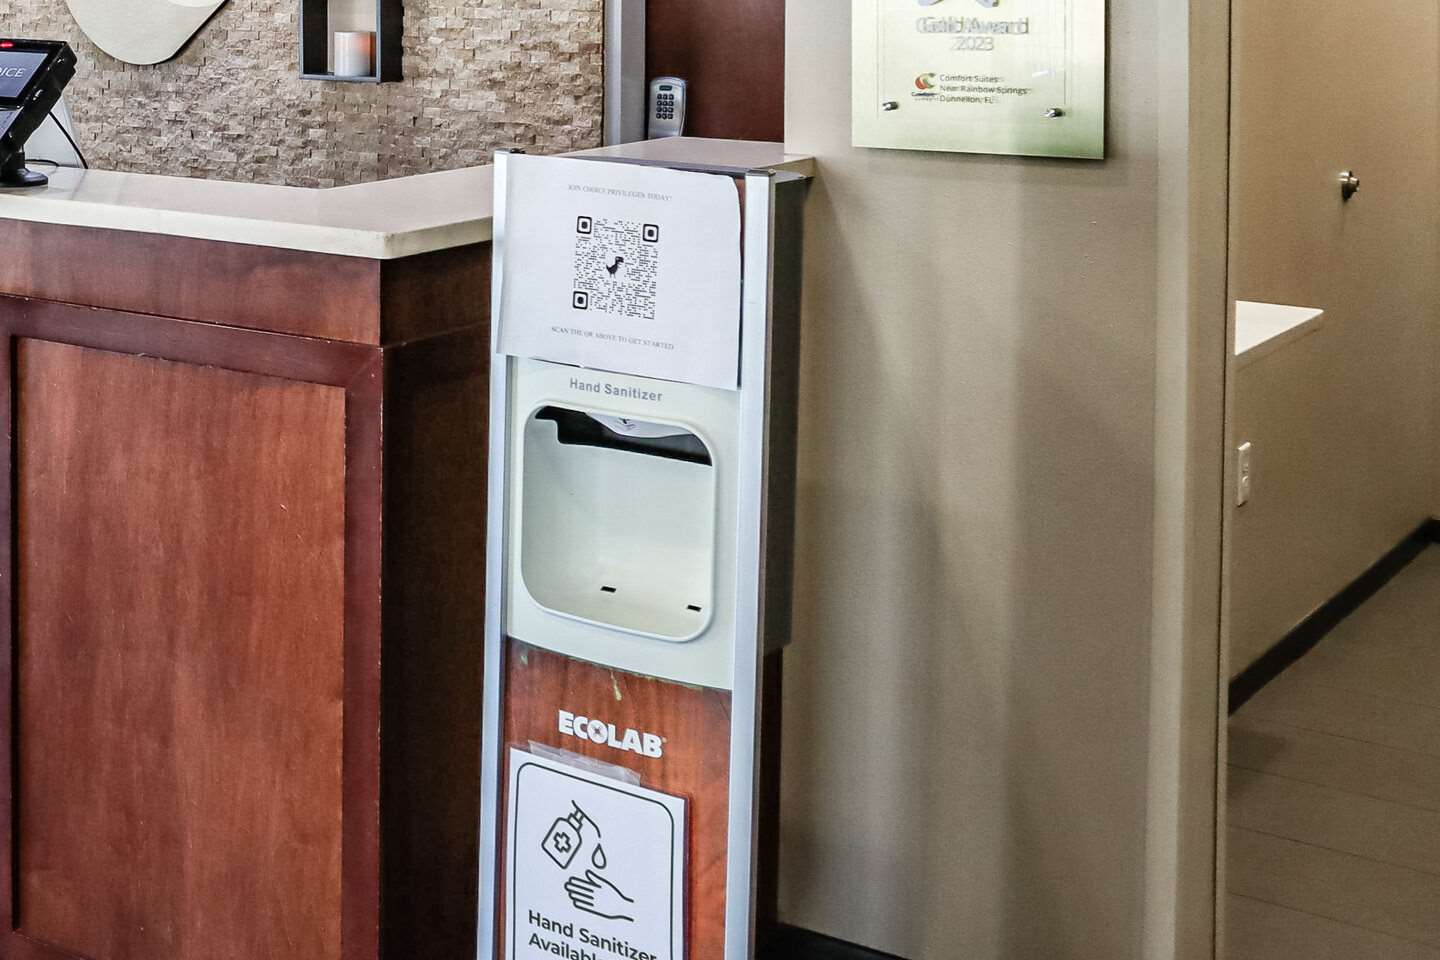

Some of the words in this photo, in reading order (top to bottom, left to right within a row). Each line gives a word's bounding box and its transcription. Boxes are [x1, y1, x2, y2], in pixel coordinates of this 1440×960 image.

[569, 378, 600, 393] Hand
[604, 384, 663, 401] Sanitizer
[559, 709, 663, 758] ECOLAB
[528, 909, 574, 938] Hand
[528, 933, 601, 960] Availab
